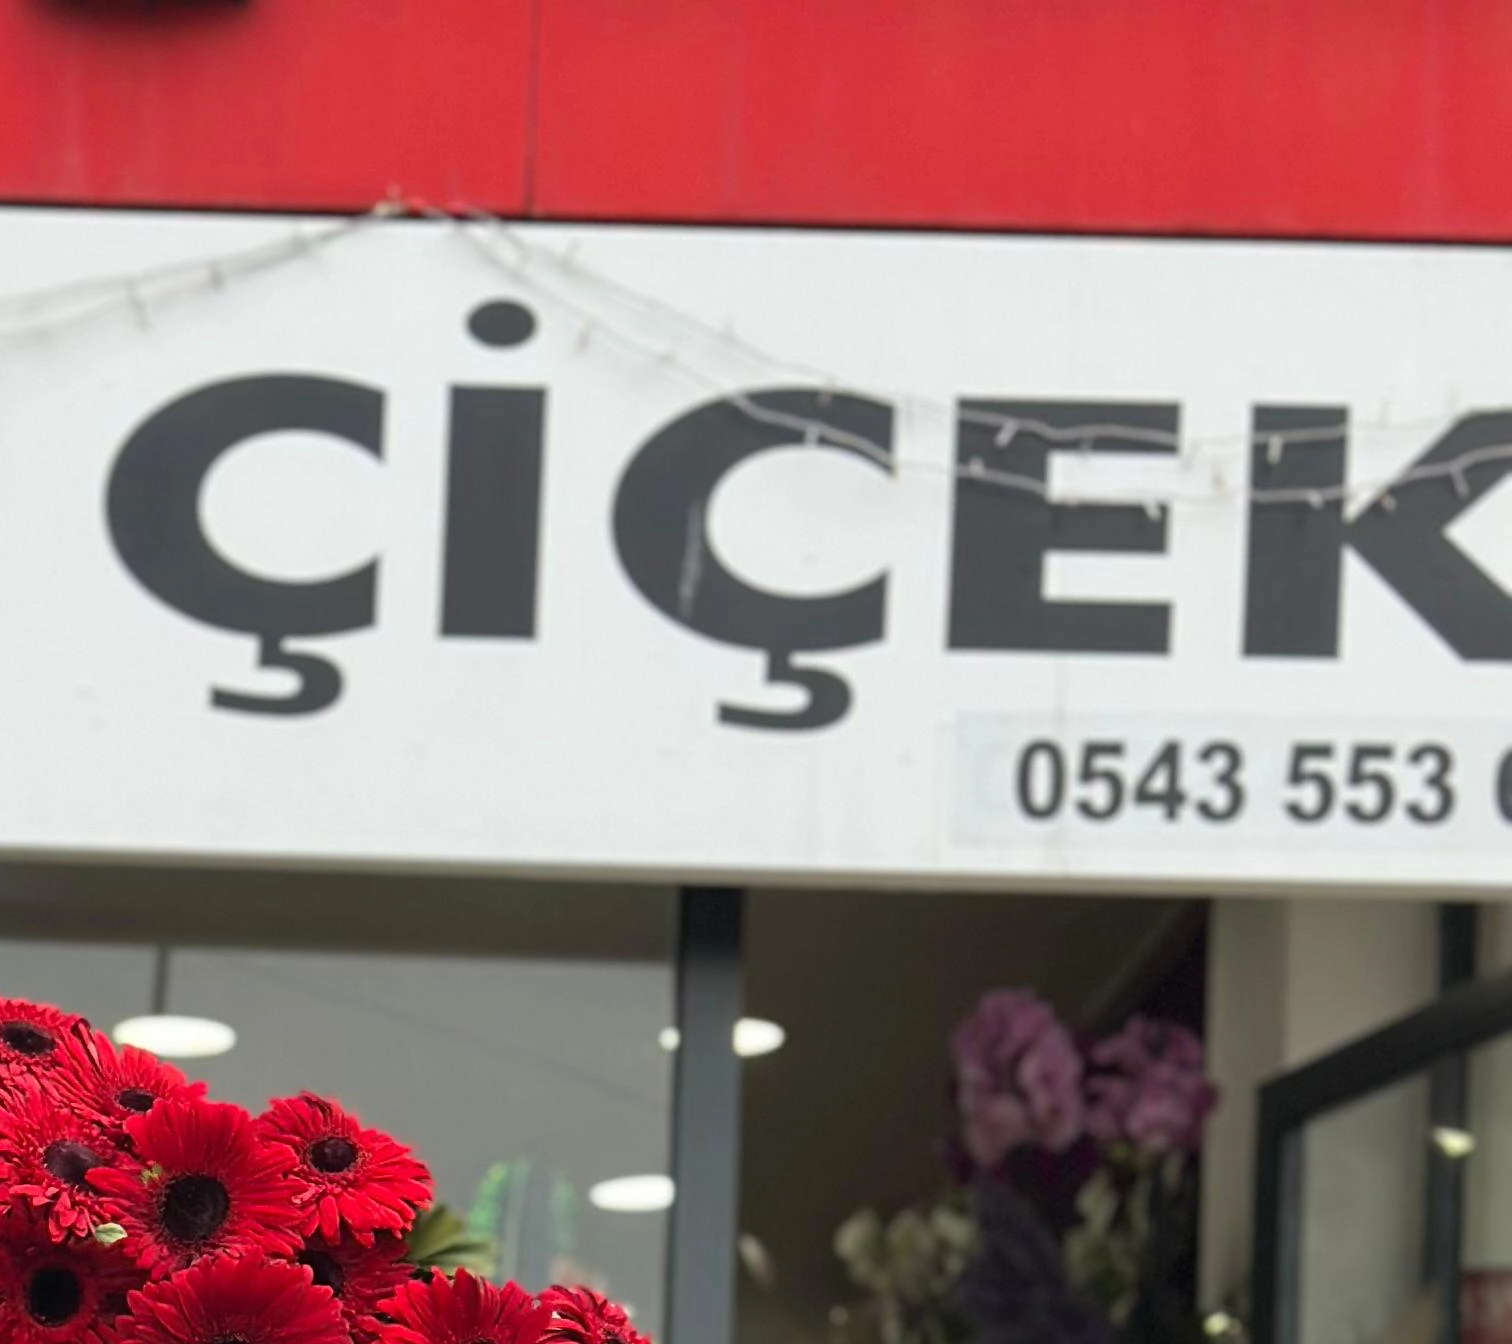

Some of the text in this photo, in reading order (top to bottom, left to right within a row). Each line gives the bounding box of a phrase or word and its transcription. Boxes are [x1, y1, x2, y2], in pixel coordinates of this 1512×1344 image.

[103, 299, 1512, 733] ÇİÇEK
[1015, 738, 1245, 823] 0543
[1284, 742, 1455, 825] 553
